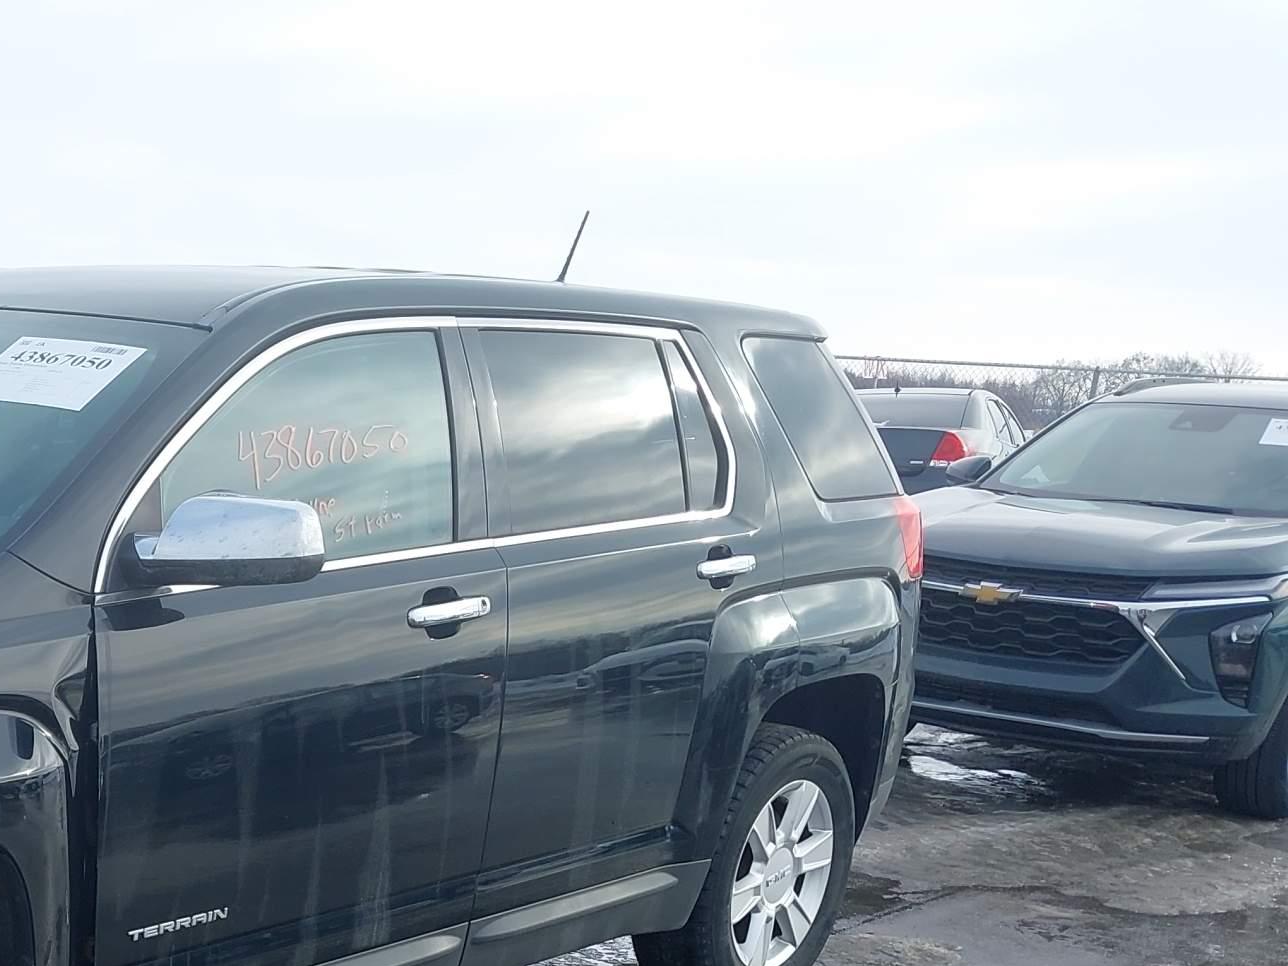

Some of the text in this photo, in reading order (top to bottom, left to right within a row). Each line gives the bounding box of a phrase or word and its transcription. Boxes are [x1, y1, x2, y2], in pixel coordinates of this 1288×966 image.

[10, 349, 113, 370] 43867050
[239, 424, 409, 491] 43867050
[128, 907, 229, 942] TERRAIN
